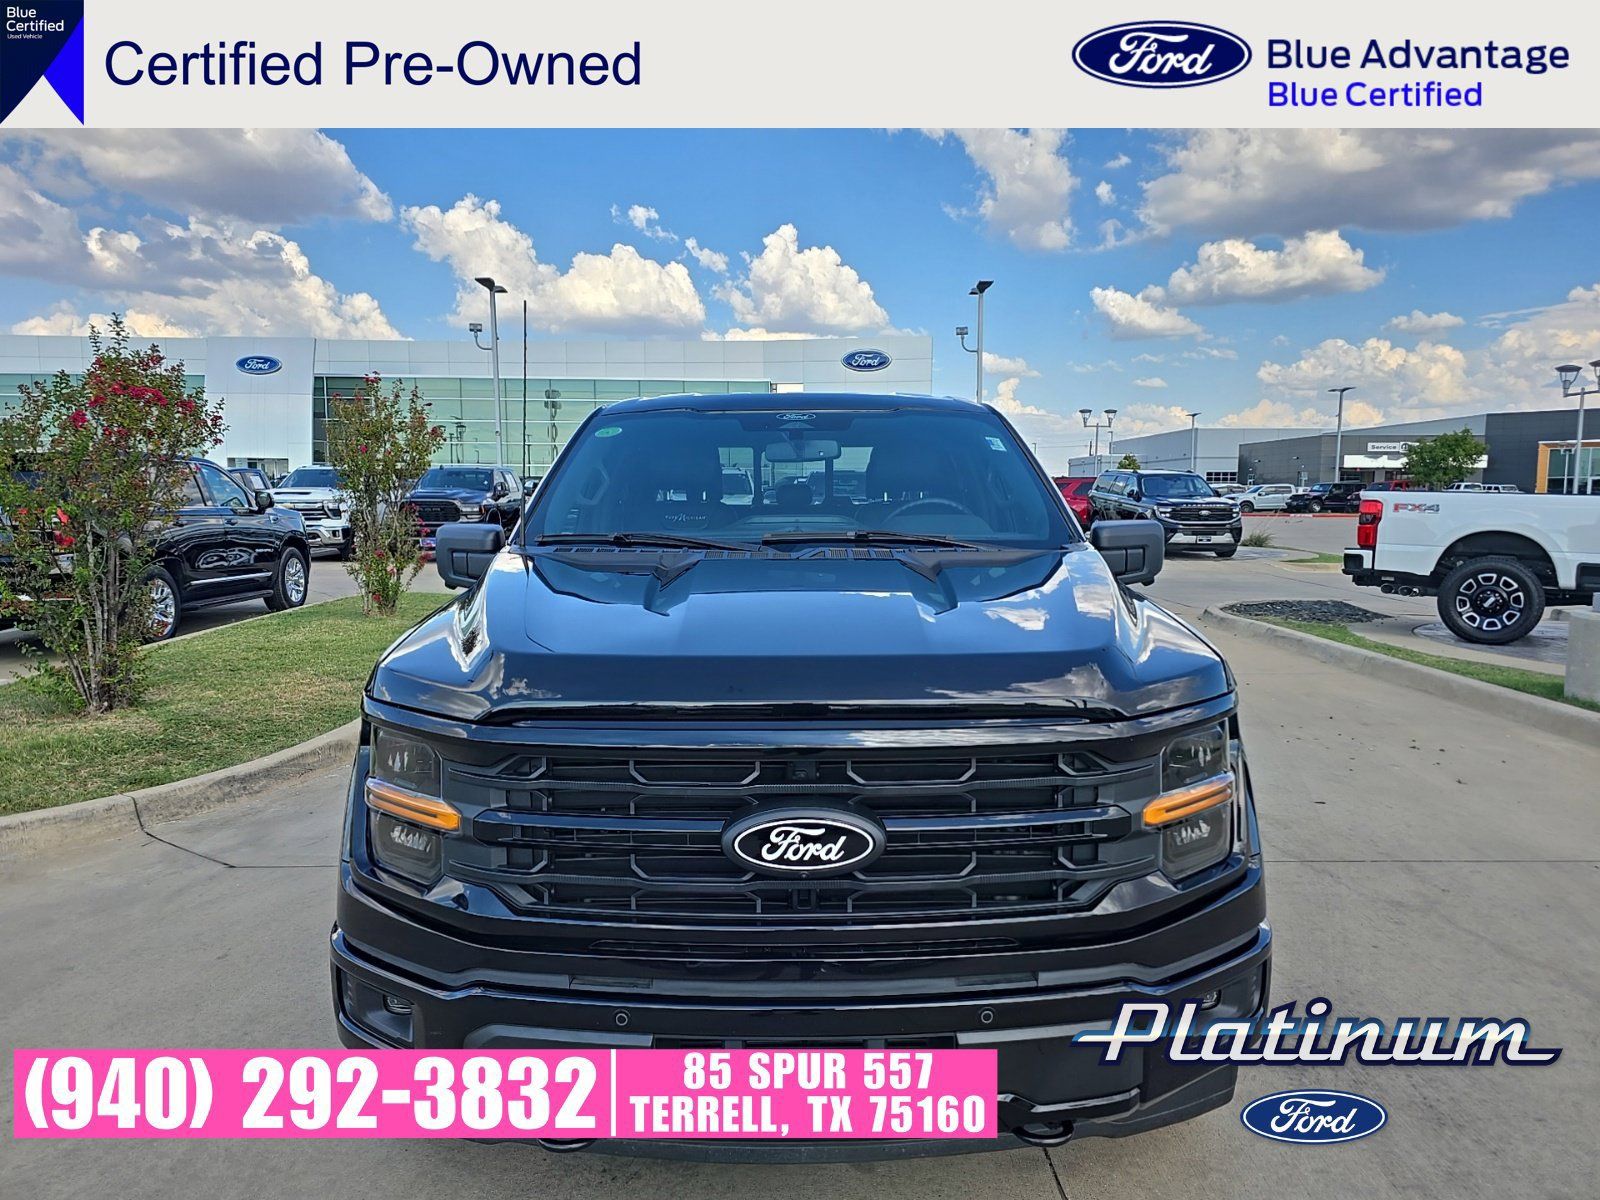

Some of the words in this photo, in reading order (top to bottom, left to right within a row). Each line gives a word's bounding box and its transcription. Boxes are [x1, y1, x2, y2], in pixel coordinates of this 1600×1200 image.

[244, 358, 271, 370] Ford
[851, 353, 881, 367] Ford
[1392, 502, 1441, 514] FX4
[760, 826, 847, 862] Ford
